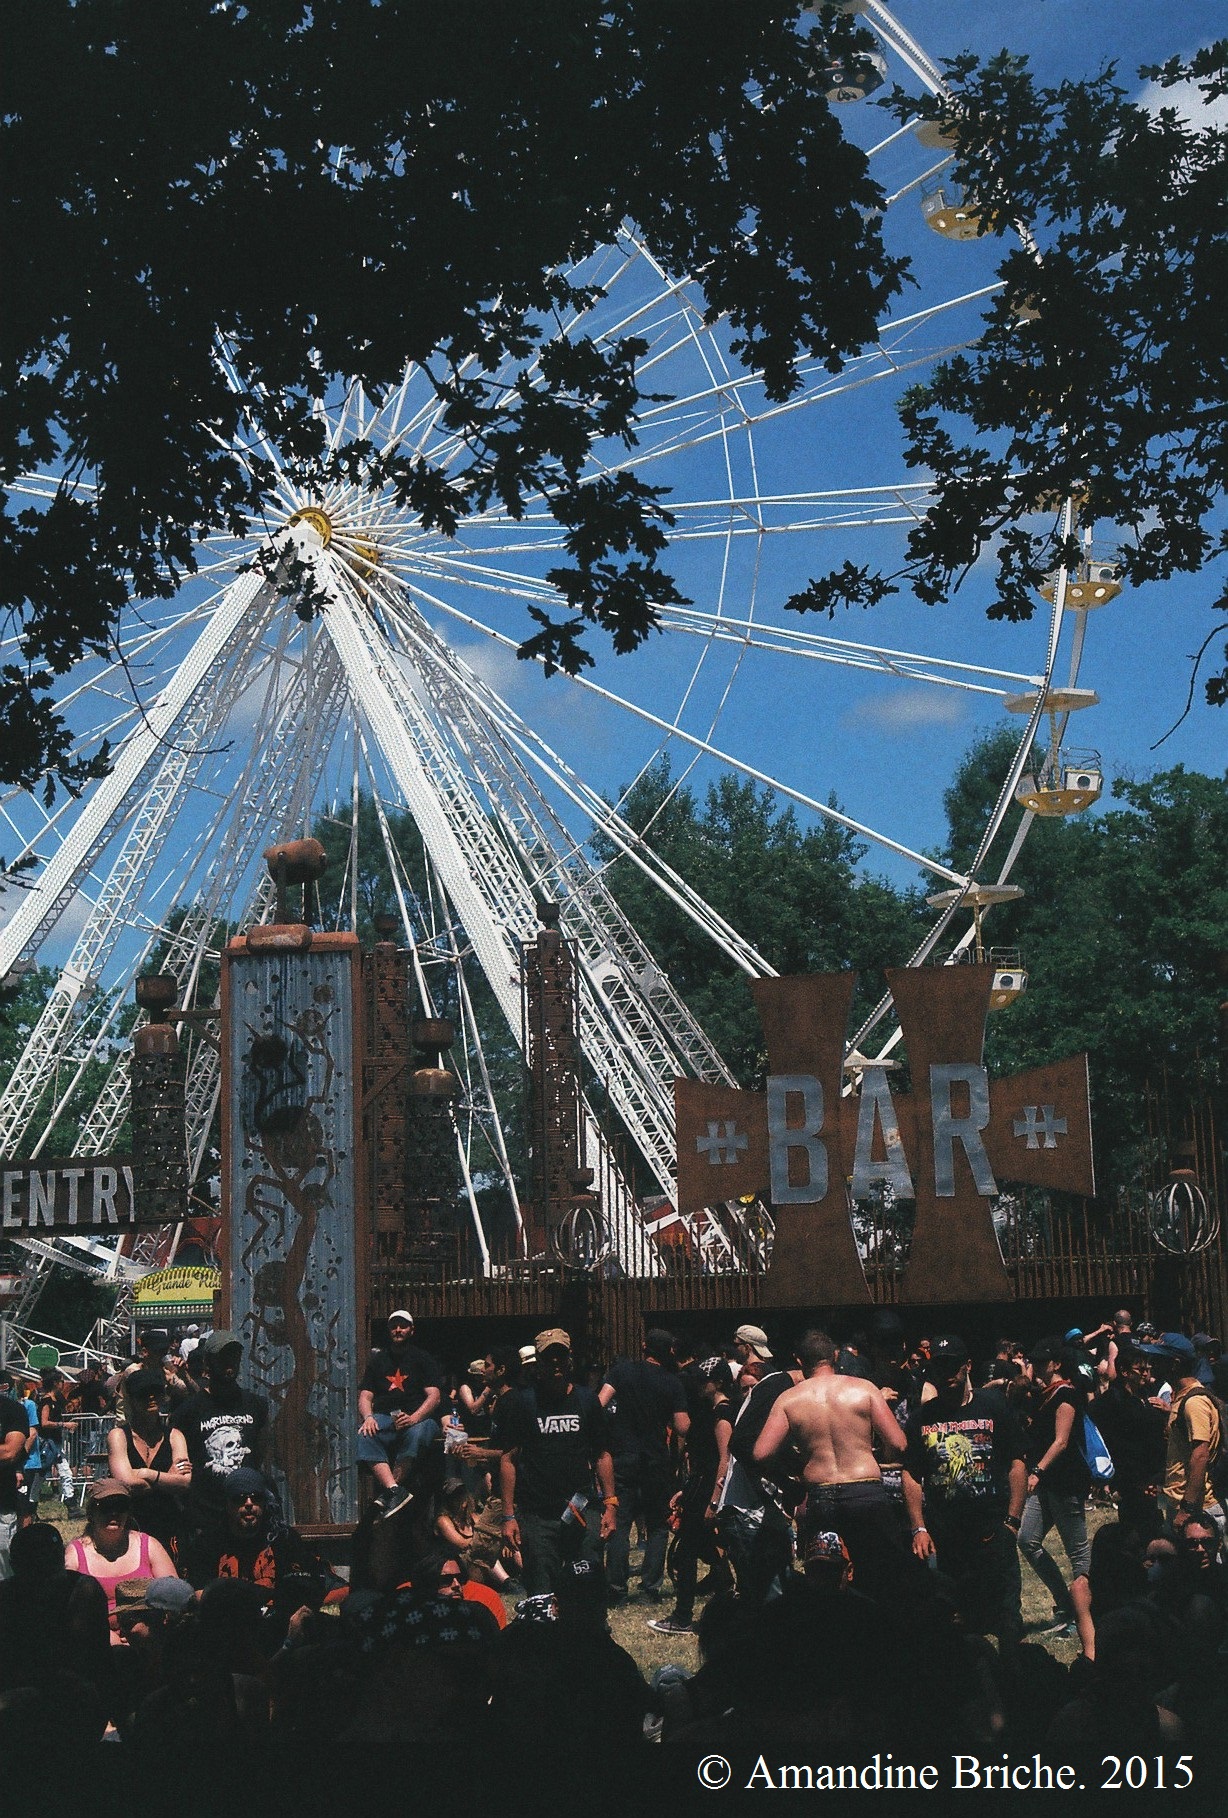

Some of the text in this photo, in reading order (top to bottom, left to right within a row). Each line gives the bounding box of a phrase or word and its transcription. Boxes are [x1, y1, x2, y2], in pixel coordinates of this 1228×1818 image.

[766, 1063, 1000, 1205] BAR
[536, 1414, 580, 1434] VANS
[948, 1418, 994, 1433] MAIDEN
